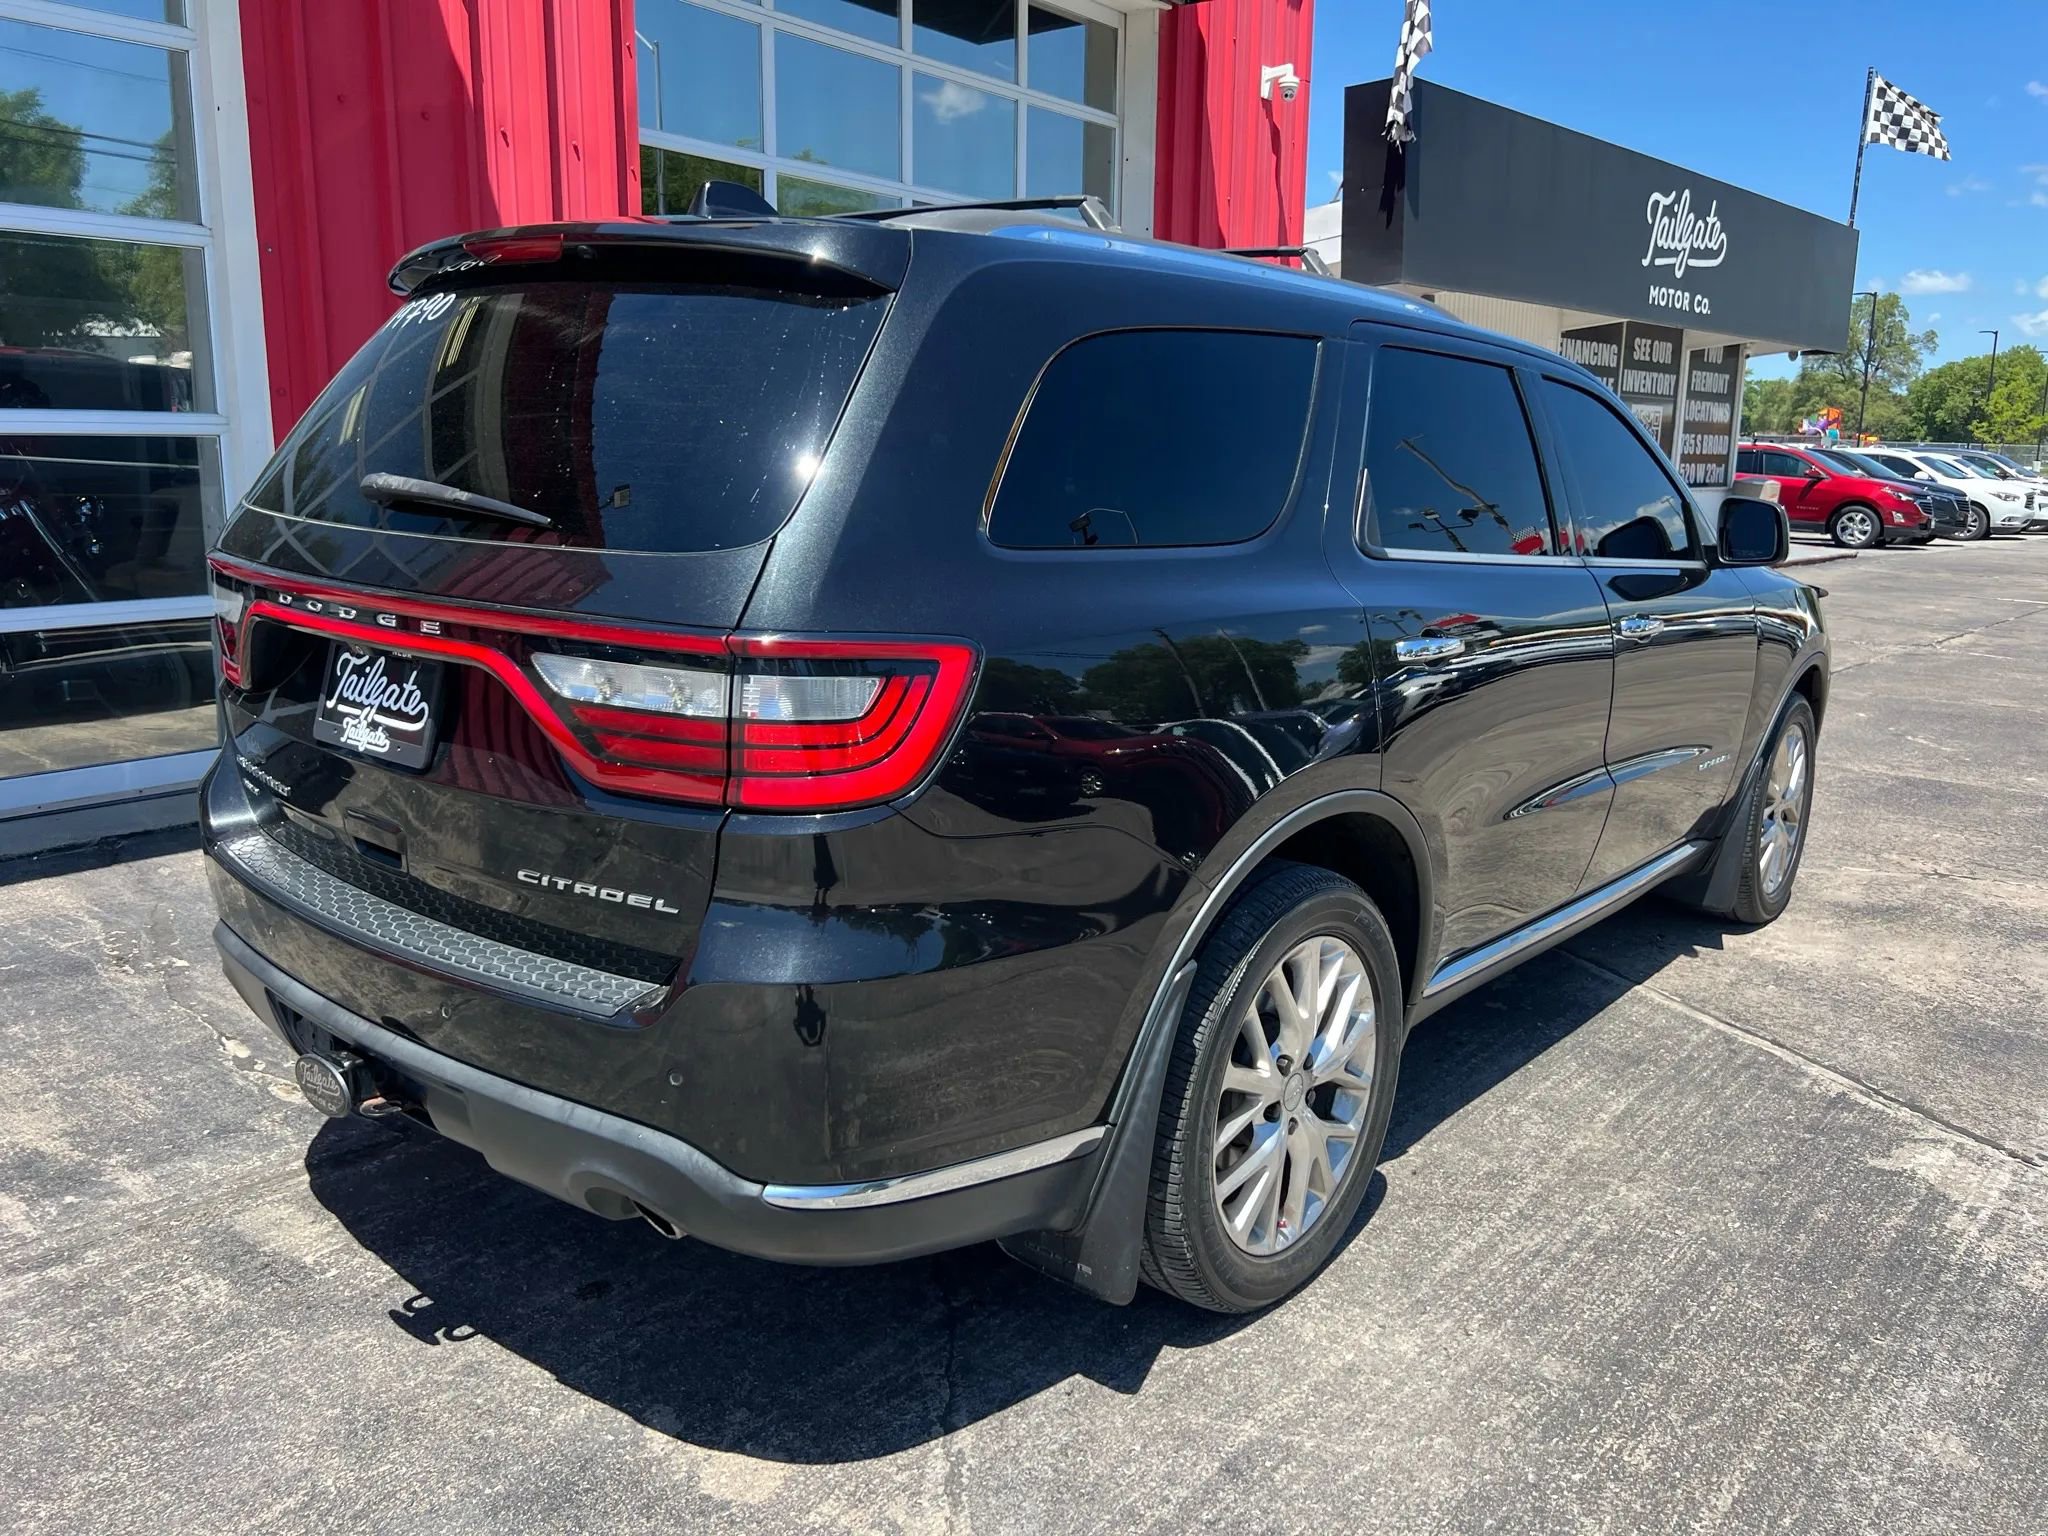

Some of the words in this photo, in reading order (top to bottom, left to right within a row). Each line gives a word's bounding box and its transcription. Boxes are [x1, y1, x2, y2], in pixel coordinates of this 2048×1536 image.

[1641, 188, 1727, 279] Tailgate
[1648, 284, 1690, 312] MOTOR
[1558, 337, 1618, 368] FINANCING
[1633, 336, 1651, 363] SEE
[1652, 340, 1673, 365] OUR
[1703, 346, 1724, 364] TWO
[1622, 369, 1677, 396] INVENTORY
[1690, 370, 1730, 395] FREMONT
[1685, 402, 1731, 424] LOCATIONS
[1695, 434, 1702, 455] S
[1702, 434, 1729, 456] BROAD
[1680, 463, 1696, 484] 520
[1696, 463, 1706, 484] W
[1705, 463, 1725, 484] 23rd
[278, 592, 441, 635] DODGE
[326, 652, 430, 732] Tailgate
[340, 717, 390, 753] Tailgate
[516, 868, 680, 914] CITADEL
[299, 1061, 341, 1097] Tailgate
